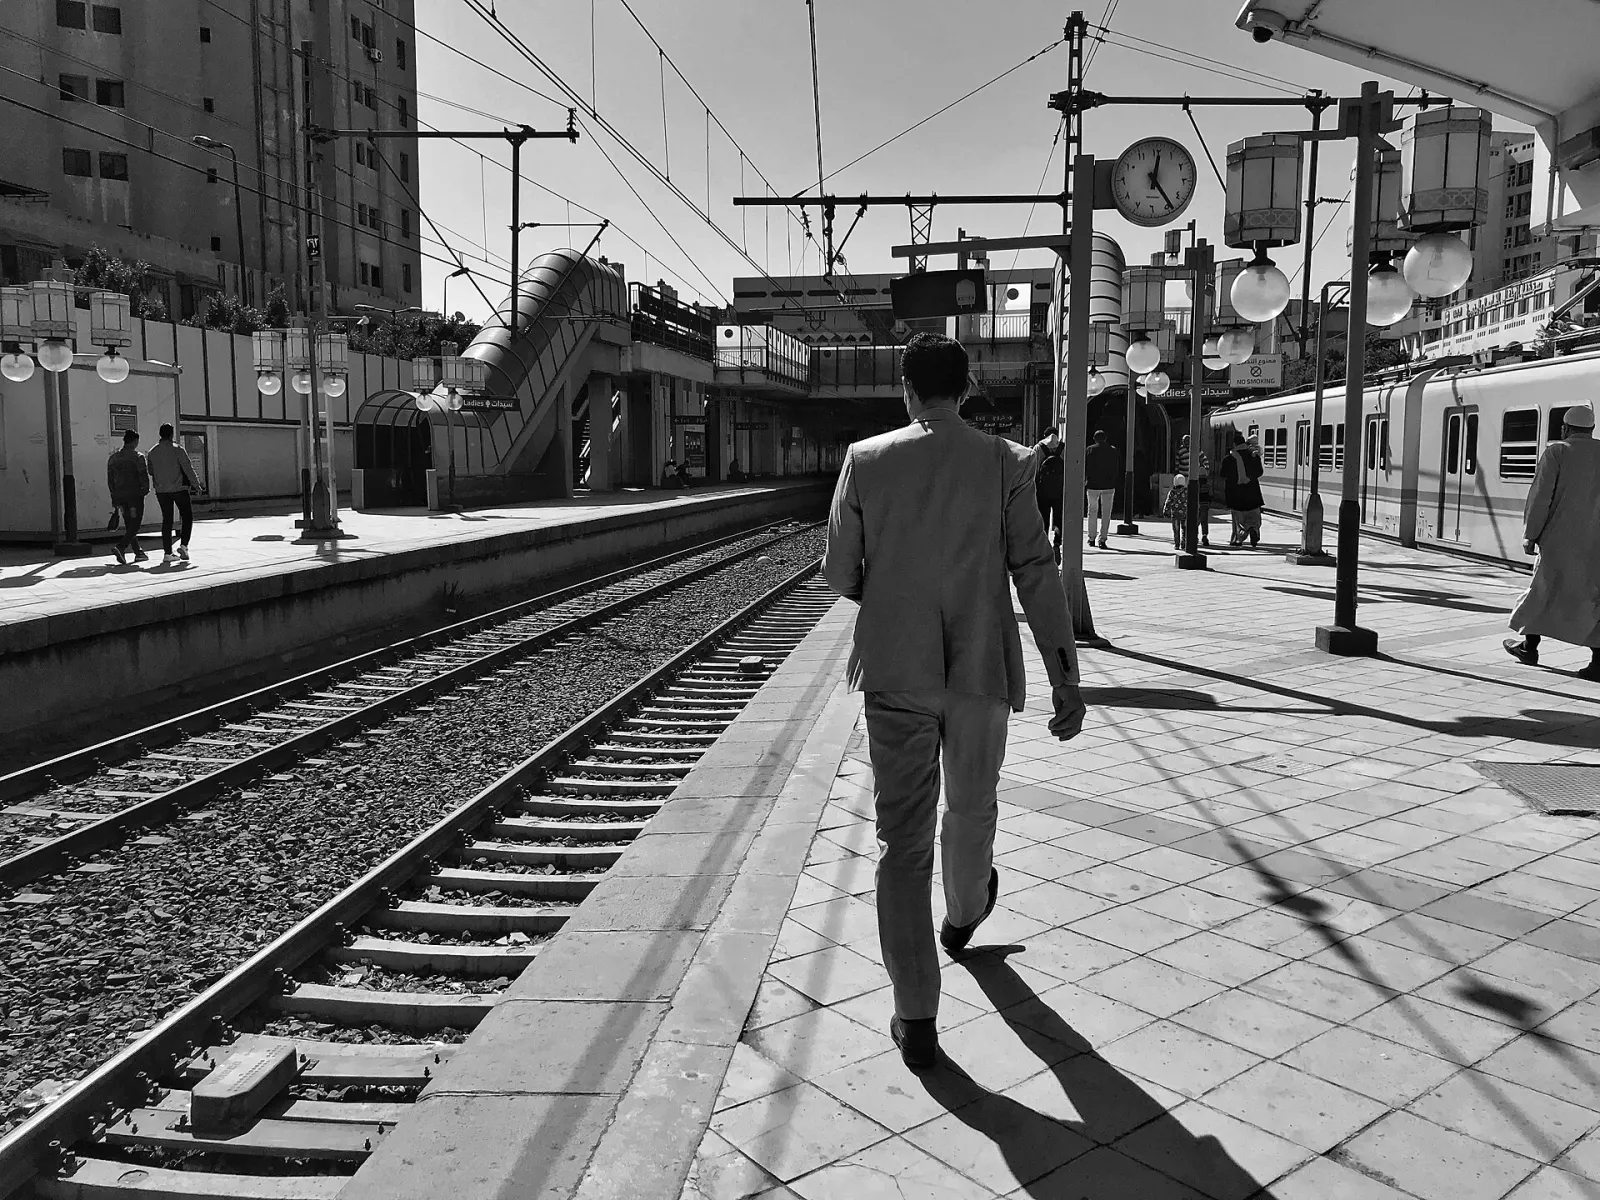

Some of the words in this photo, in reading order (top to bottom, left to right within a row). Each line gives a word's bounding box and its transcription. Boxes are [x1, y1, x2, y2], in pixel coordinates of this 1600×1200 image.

[1125, 191, 1130, 200] ٨
[1135, 201, 1140, 209] ٧
[1149, 204, 1154, 213] ٦
[1257, 358, 1277, 366] ممنوع
[1246, 377, 1276, 385] SMOKING
[491, 400, 514, 408] سيدات
